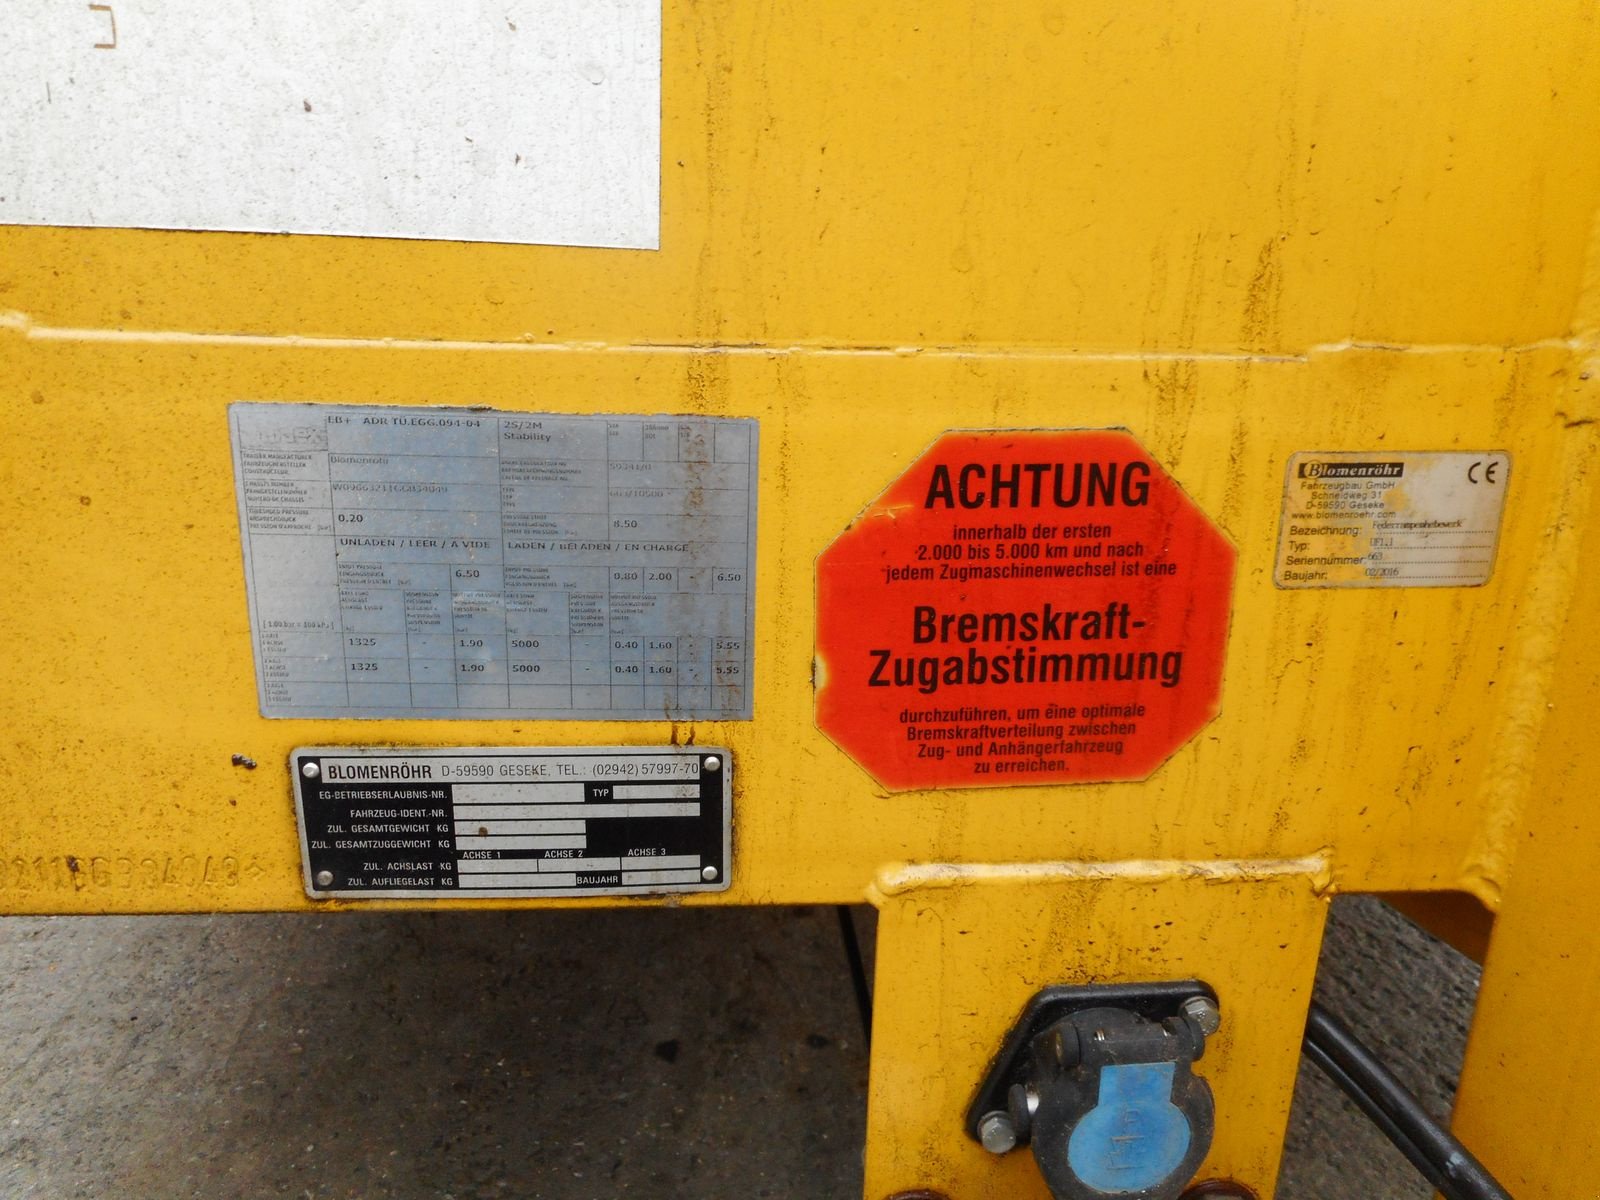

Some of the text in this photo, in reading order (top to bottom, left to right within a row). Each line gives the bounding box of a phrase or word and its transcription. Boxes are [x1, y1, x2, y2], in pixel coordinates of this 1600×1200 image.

[328, 415, 351, 424] EB+
[363, 417, 388, 425] ADR
[504, 432, 551, 442] Stability
[1304, 462, 1401, 478] Blomenröhr
[924, 460, 1151, 509] ACHTUNG
[1301, 480, 1395, 491] Fahrzeugbau GmbH
[1311, 491, 1382, 500] Schneidweg 31
[1306, 501, 1385, 510] D-59590 Geseke
[338, 514, 364, 523] 0.20
[1292, 510, 1397, 519] www.blomenroehr.com
[613, 520, 638, 528] 8.50
[952, 522, 1112, 541] innerhalb der ersten
[1289, 525, 1362, 537] Bezeichnung:
[340, 538, 395, 547] UNLADEN
[409, 539, 437, 548] LEER
[462, 541, 491, 549] VIDE
[508, 541, 546, 550] LADEN
[560, 543, 611, 551] BELADEN
[625, 543, 641, 551] EN
[643, 544, 688, 552] CHARGE
[1288, 540, 1310, 552] Typ:
[917, 541, 1143, 560] 2.000 bis 5.000 km und nach
[1286, 555, 1367, 566] Seriennummer:
[455, 569, 480, 578] 6.50
[614, 572, 741, 582] 0.80 2.00 6.50
[885, 560, 1177, 584] jedem Zugmaschinenwechsel ist eine
[1284, 567, 1400, 583] Baujahr: 02/2016
[912, 602, 1146, 644] Bremskraft-
[348, 637, 376, 646] 1325
[460, 639, 483, 647] 1.90
[511, 639, 539, 648] 5000
[614, 641, 638, 649] 0.40
[649, 641, 672, 649] 1.60
[351, 662, 739, 674] 1325 1.90 5000 0.40 1.60 5.55
[867, 645, 1184, 694] Zugabstimmung
[899, 703, 1146, 723] durchzuführen, um eine optimale
[906, 721, 1137, 741] Bremskraftverteilung zwischen
[917, 740, 1124, 761] Zug- und Anhängerfahrzeug
[328, 761, 699, 780] BLOMENRÖHR D-59590 GESEKE, TEL.: (02942) 57997-70
[974, 759, 1070, 774] zu erreichen.
[319, 788, 610, 800] EG-BETRIEBSERLAUBNIS-NR. TYP
[350, 809, 448, 818] FAHRZEUG-IDENT.-NR.
[327, 824, 449, 833] ZUL. GESAMTGEWICHT KG
[311, 840, 450, 849] ZUL. GESAMTZUGGEWICHT KG
[462, 851, 501, 860] ACHSE 1
[544, 850, 584, 859] ACHSE 2
[628, 847, 666, 857] ACHSE 3
[363, 862, 452, 871] ZUL. ACHSLAST KG
[348, 877, 453, 887] ZUL. AUFLIEGELAST KG
[576, 875, 619, 885] BAUJAHR
